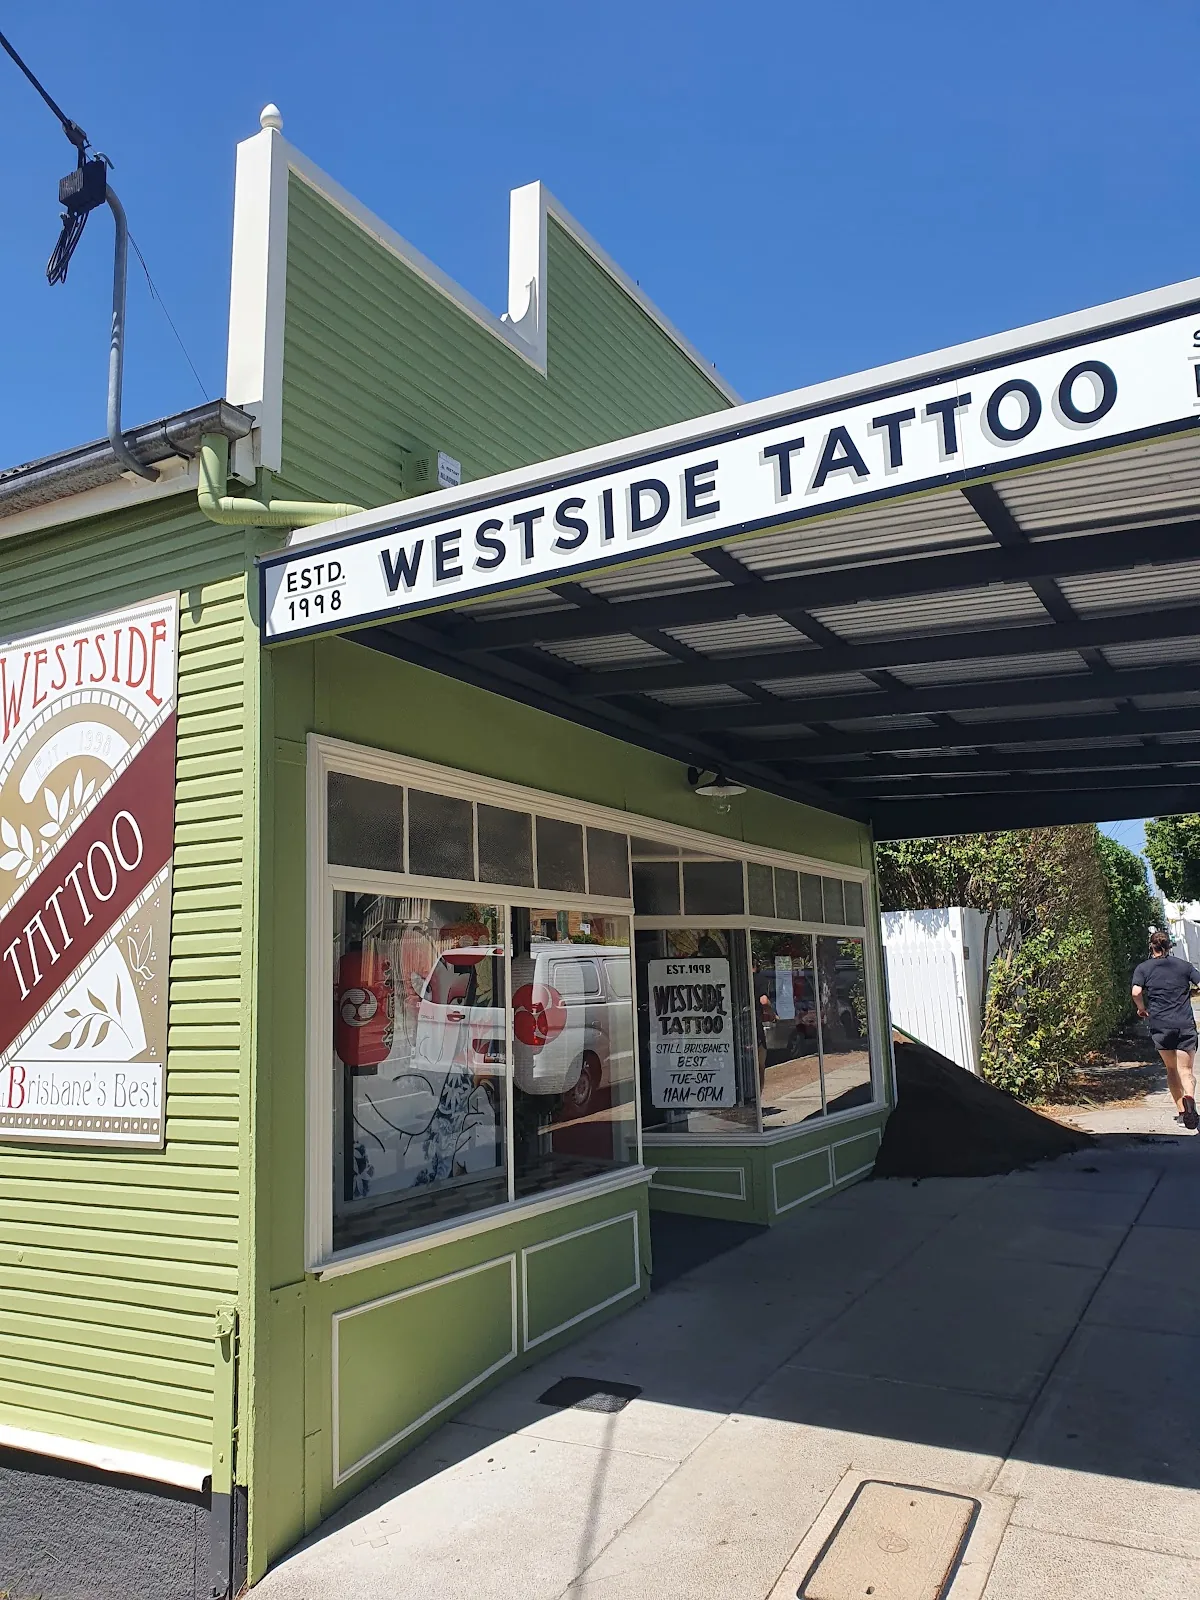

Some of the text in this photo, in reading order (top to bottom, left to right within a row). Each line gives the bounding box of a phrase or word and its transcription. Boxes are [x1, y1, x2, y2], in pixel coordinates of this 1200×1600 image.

[379, 360, 1118, 595] WESTSIDE TATTOO
[286, 561, 346, 593] ESTD.
[288, 589, 342, 621] 1998
[0, 618, 167, 744] WESTSIDE
[3, 809, 144, 1001] TATTOO
[652, 983, 728, 1017] WESTSIDE
[658, 1015, 724, 1036] TATTOO
[655, 1043, 682, 1054] STILL
[677, 1056, 707, 1067] BEST
[7, 1065, 107, 1109] Brisbane's
[114, 1073, 160, 1108] Best
[669, 1072, 716, 1084] TUE-SAT
